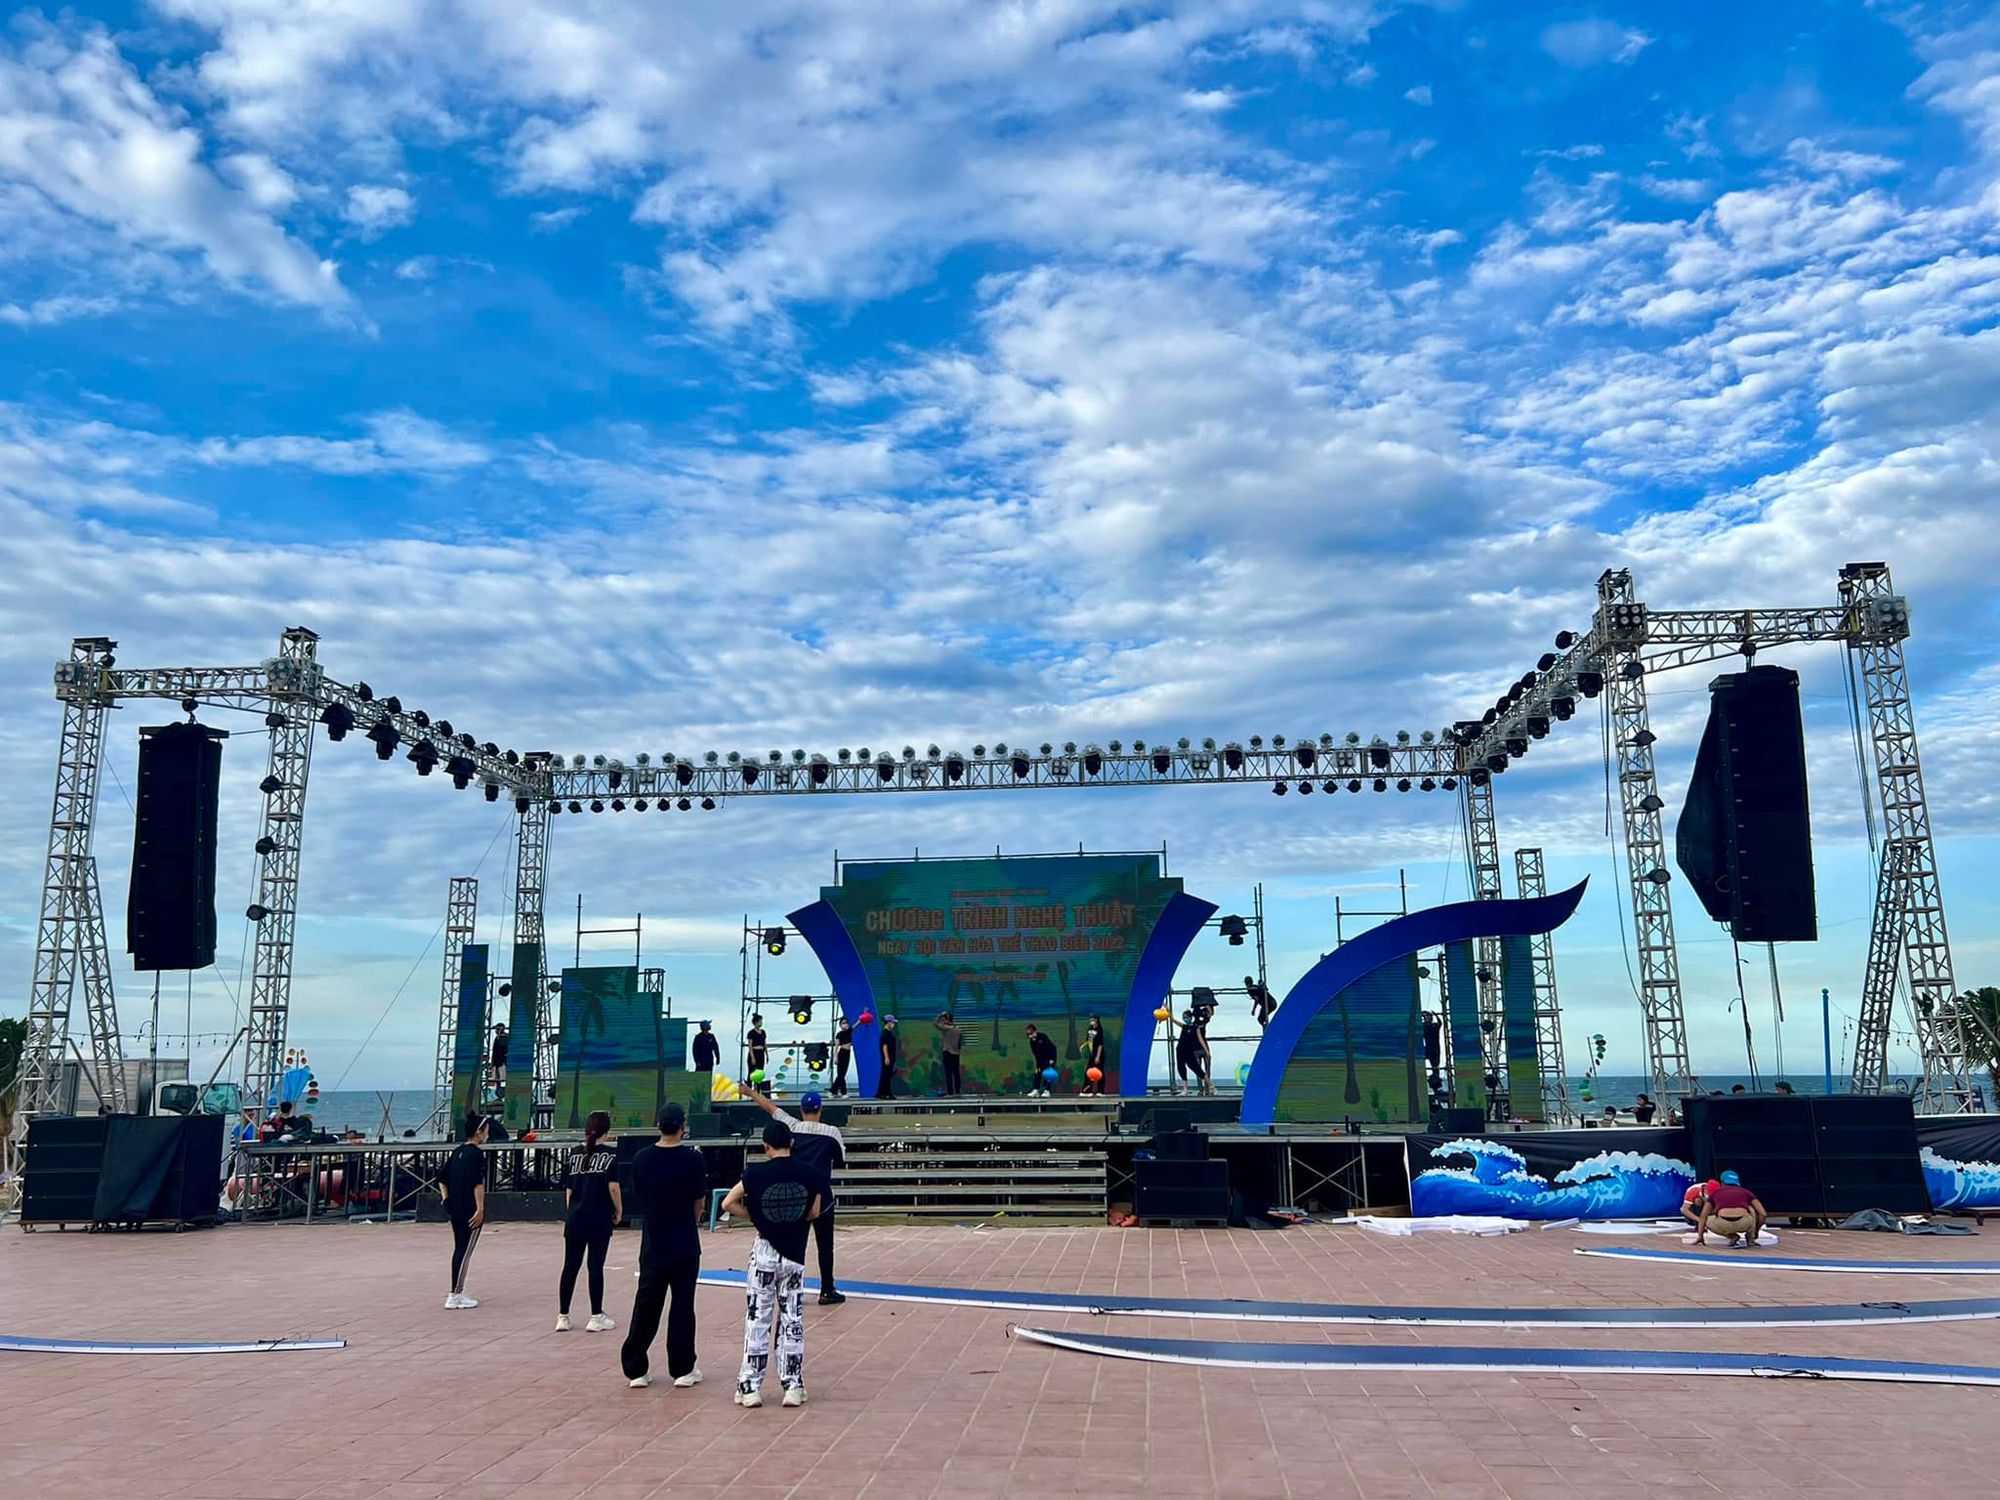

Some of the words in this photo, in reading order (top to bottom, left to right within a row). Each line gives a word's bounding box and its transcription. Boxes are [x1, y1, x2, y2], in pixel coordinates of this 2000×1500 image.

[865, 907, 944, 932] CHƯƠNG
[951, 902, 1008, 930] TRÌNH
[1014, 902, 1065, 931] NGHỆ
[1073, 899, 1135, 928] THUẬT
[1024, 935, 1057, 951] THAO
